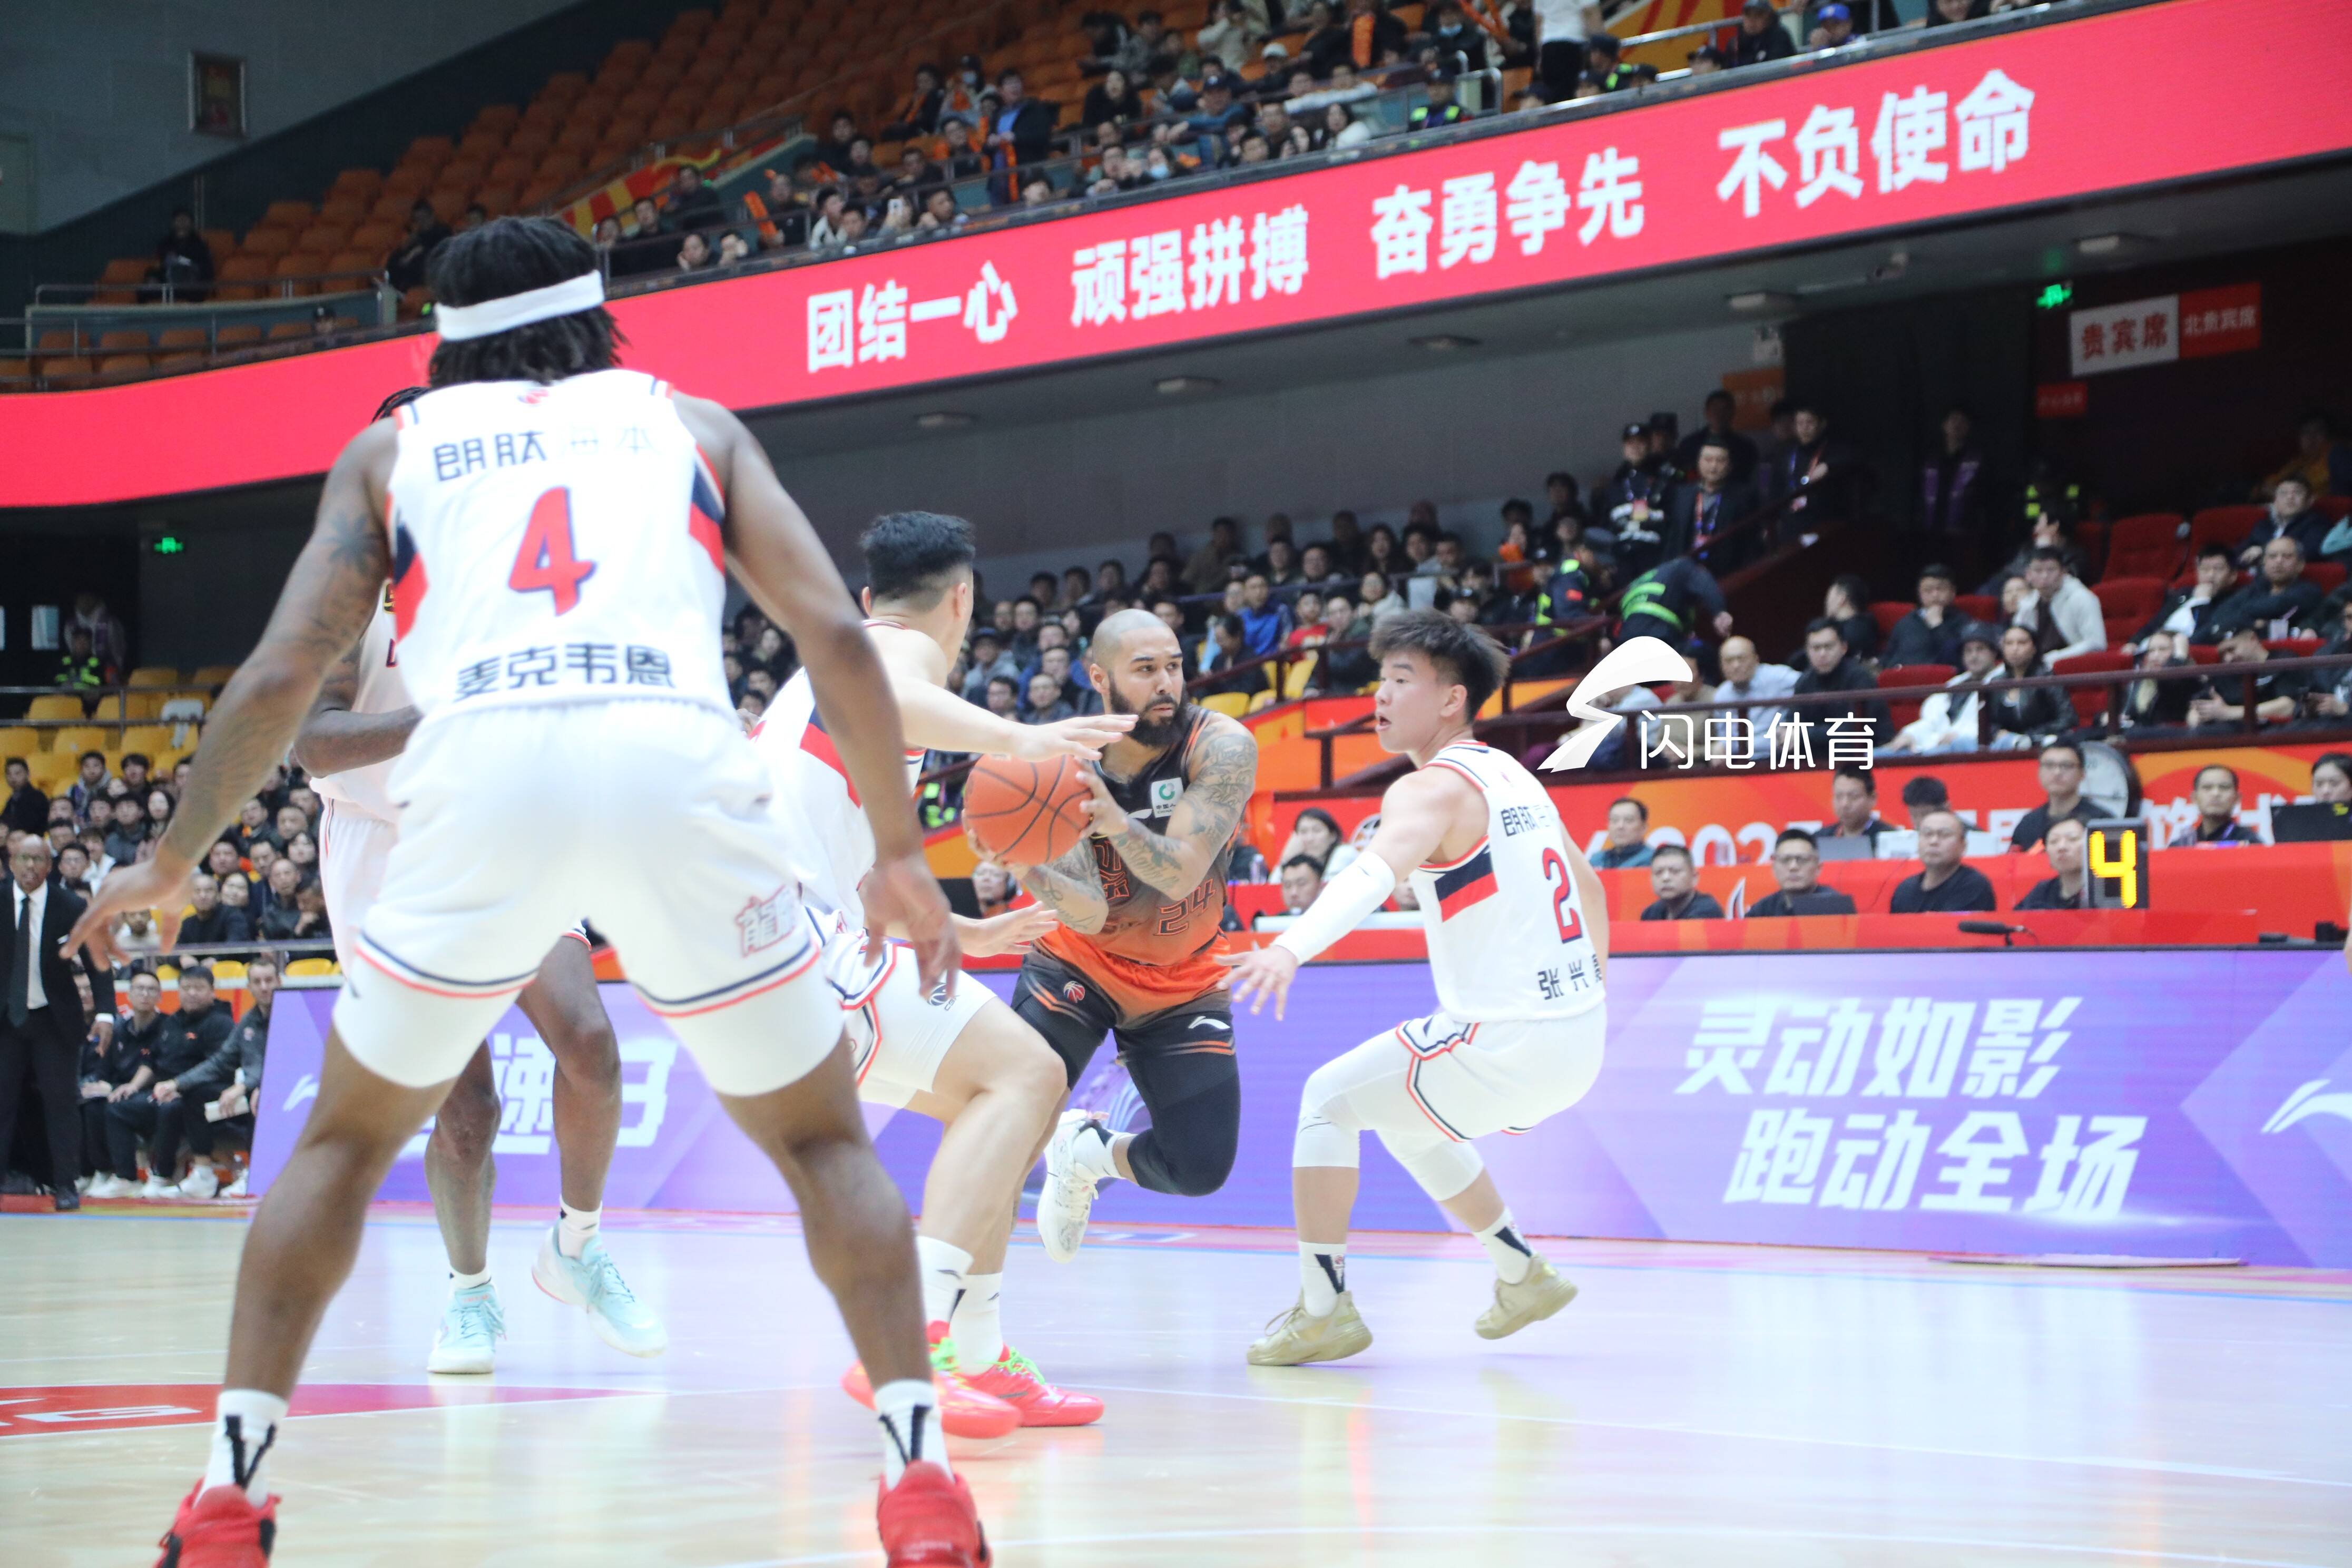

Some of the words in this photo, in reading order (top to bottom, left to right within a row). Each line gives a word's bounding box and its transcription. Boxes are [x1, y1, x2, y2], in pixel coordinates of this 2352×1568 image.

[806, 260, 1018, 373] 团结一心
[1070, 203, 1310, 328] 顽强拼搏
[1370, 146, 1645, 278] 奋勇争先
[1717, 68, 2035, 218] 不负使命
[508, 486, 598, 618] 4
[455, 642, 677, 703] 麦克韦恩
[1501, 805, 1560, 837] 朗肽
[2089, 830, 2138, 909] 4
[1153, 878, 1217, 936] 24
[1542, 847, 1583, 944] 2
[1674, 996, 2083, 1099] 灵动如影
[1723, 1108, 2147, 1218] 跑动全场
